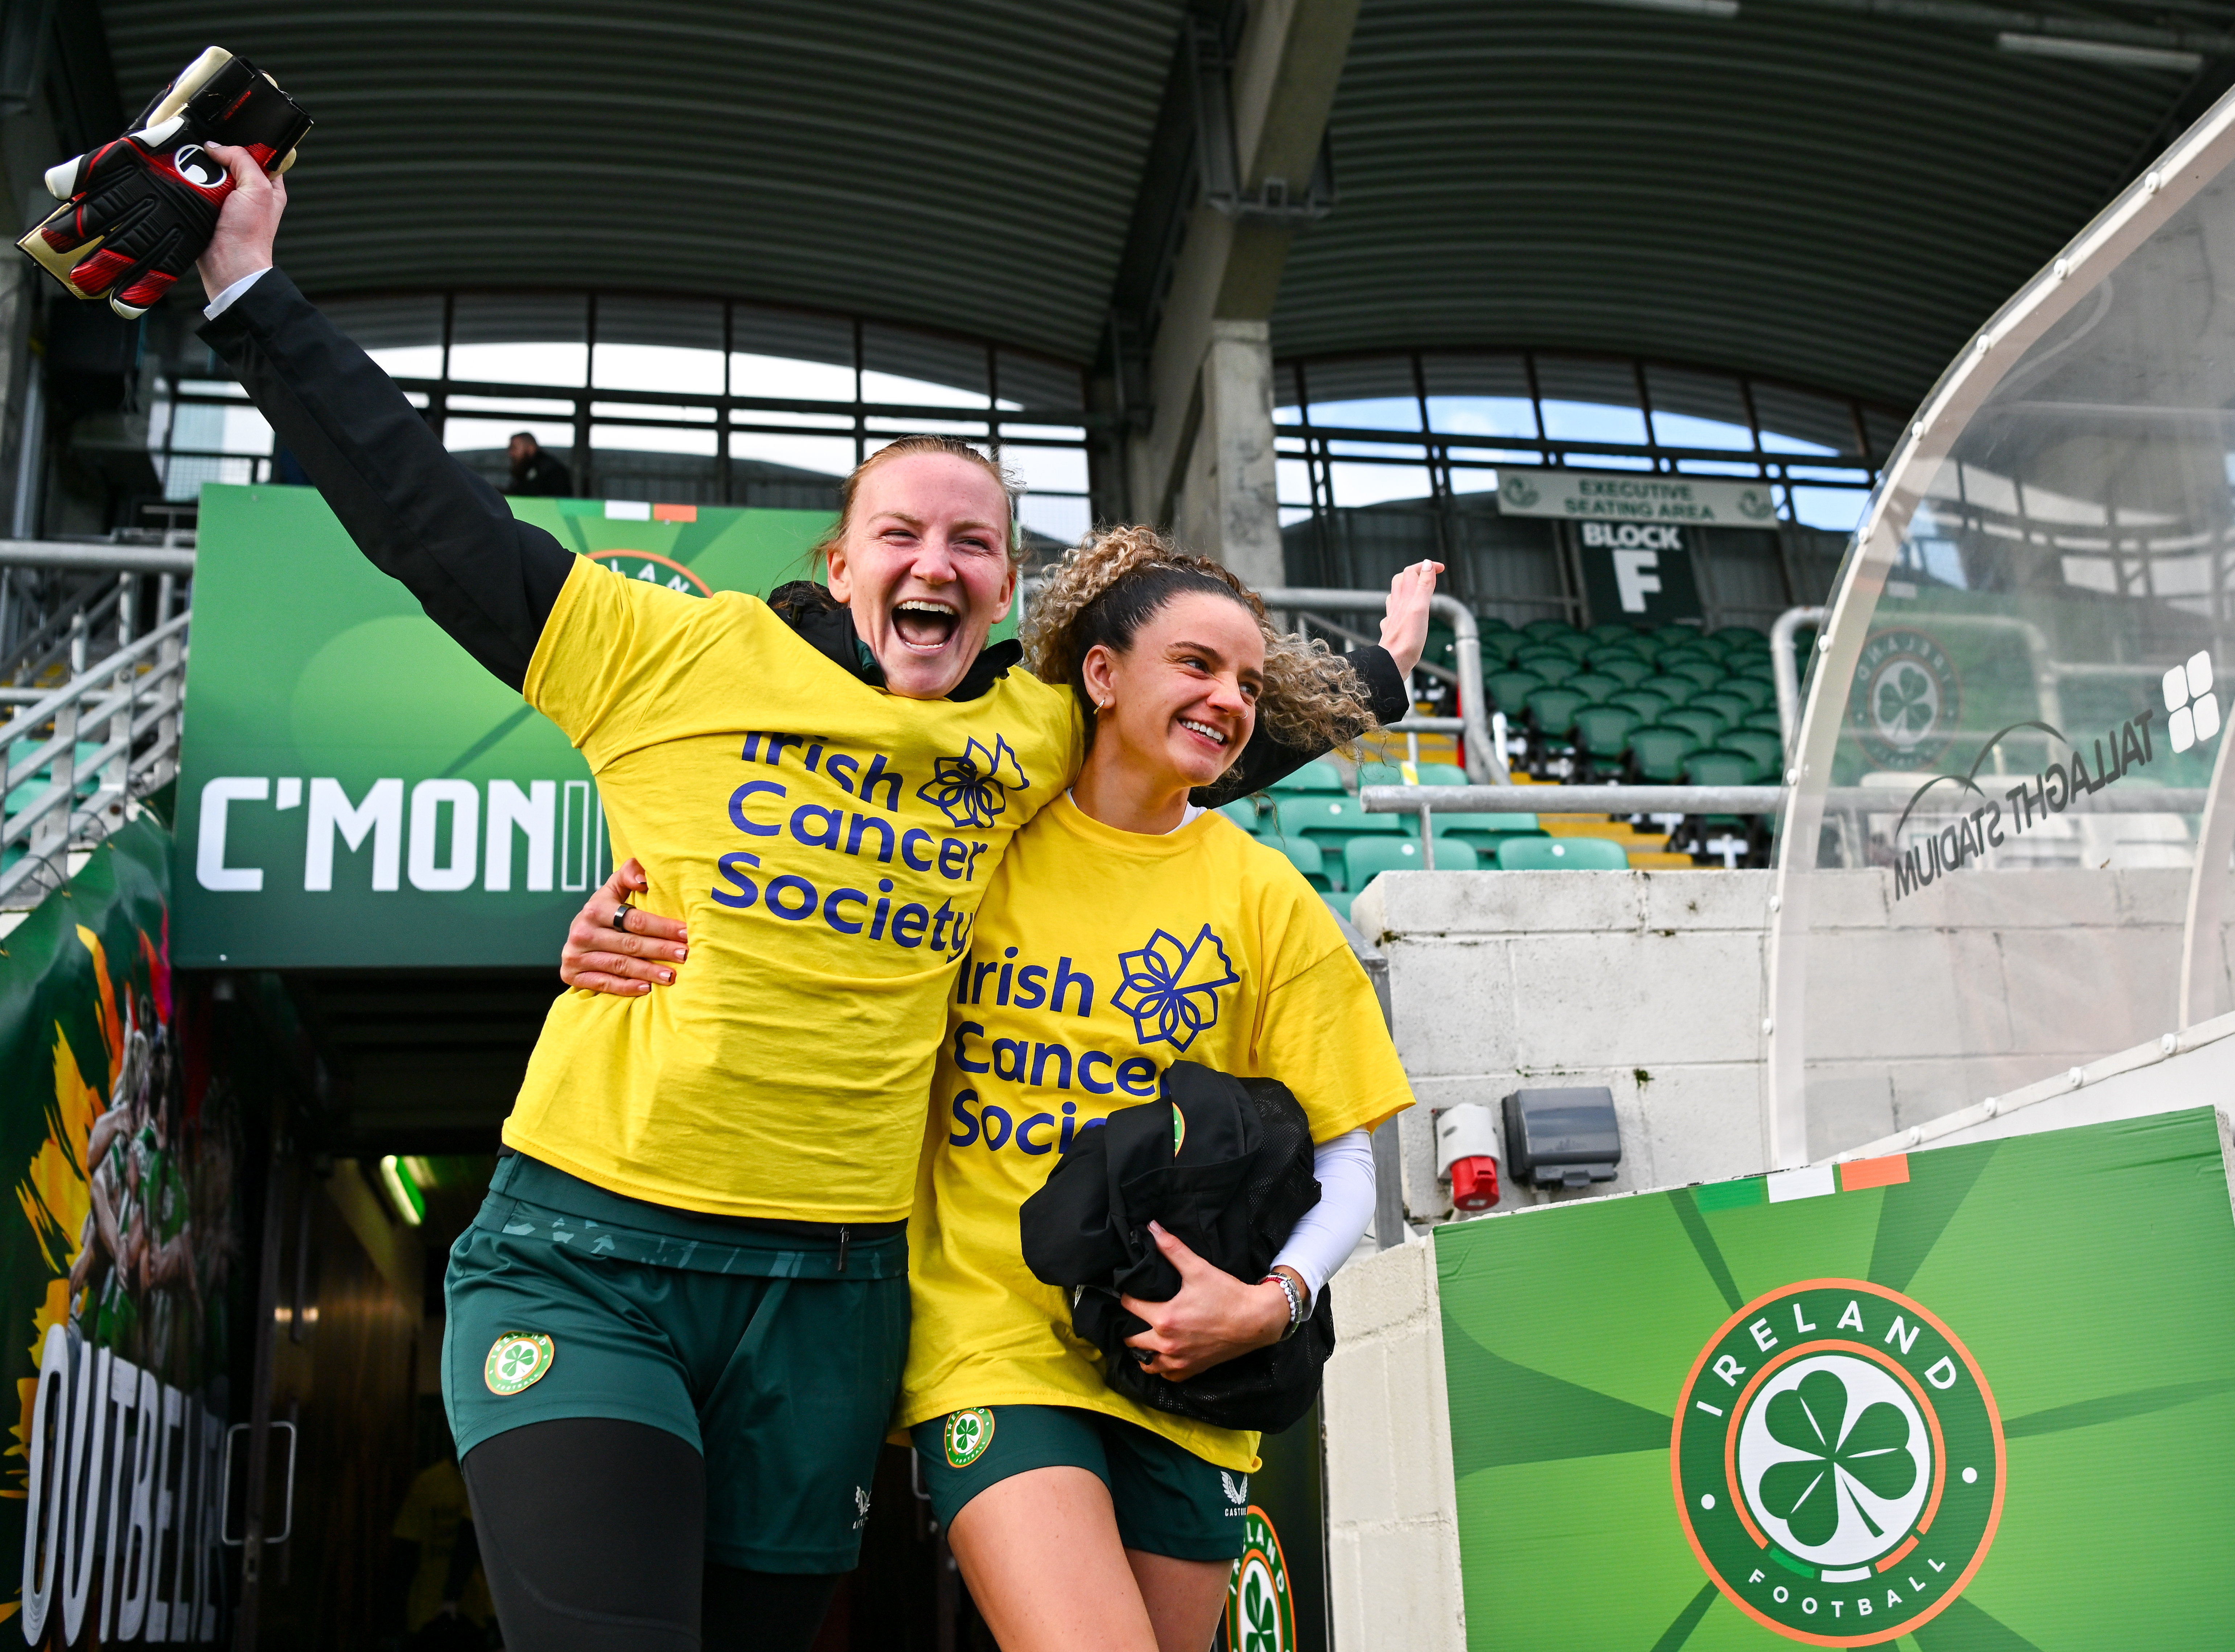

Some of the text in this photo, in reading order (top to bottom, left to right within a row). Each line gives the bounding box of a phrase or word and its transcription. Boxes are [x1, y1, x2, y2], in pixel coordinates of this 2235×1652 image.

[1565, 499, 1714, 521] SEATING AREA
[1580, 479, 1691, 499] EXECUTIVE
[1583, 523, 1682, 550] BLOCK
[1612, 550, 1661, 612] F
[742, 732, 903, 812] Irish
[728, 781, 988, 881] Cancer
[711, 852, 974, 965] Society
[956, 947, 1094, 1017] Irish
[497, 1372, 539, 1391] FOOTBALL
[1697, 1301, 1956, 1417] IRELAND
[947, 1408, 985, 1437] IRELND
[955, 1441, 986, 1463] FOOTBALL
[1748, 1557, 1946, 1618] FOOTBALL
